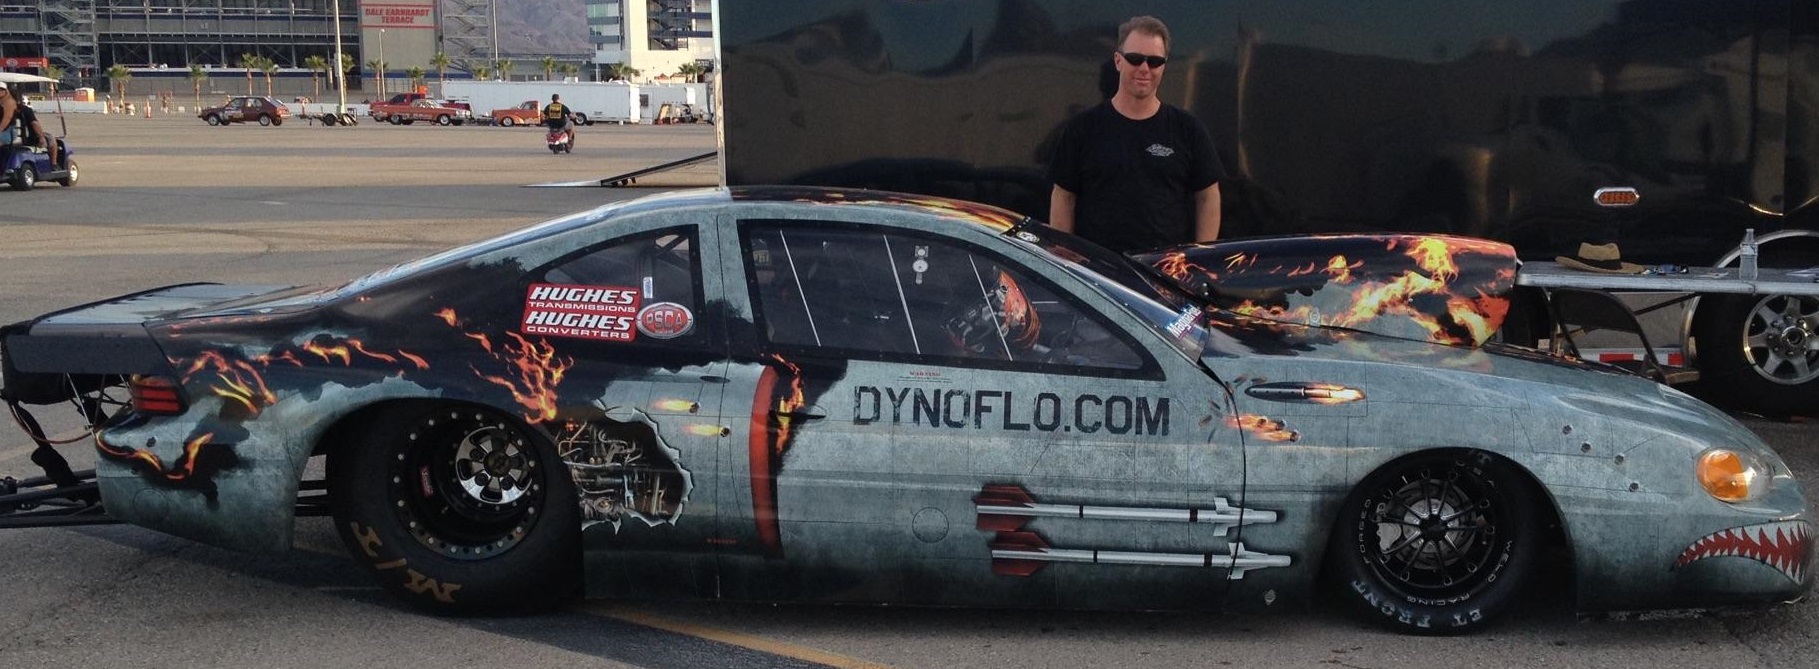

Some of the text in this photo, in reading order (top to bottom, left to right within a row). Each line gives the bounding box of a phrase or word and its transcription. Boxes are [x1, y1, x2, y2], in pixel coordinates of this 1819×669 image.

[365, 8, 429, 16] DALE EARNHARDT
[529, 286, 638, 305] HUGHES
[528, 301, 636, 313] TRANSMISSIONS
[525, 311, 634, 331] HUGHES
[646, 310, 682, 328] PSCA
[526, 326, 630, 339] CONVERTERS
[853, 385, 1170, 436] DYNOFLO.COM
[1358, 499, 1372, 564] FORGED
[1407, 540, 1514, 606] WELD RACING
[1351, 580, 1483, 628] ET FRONT
